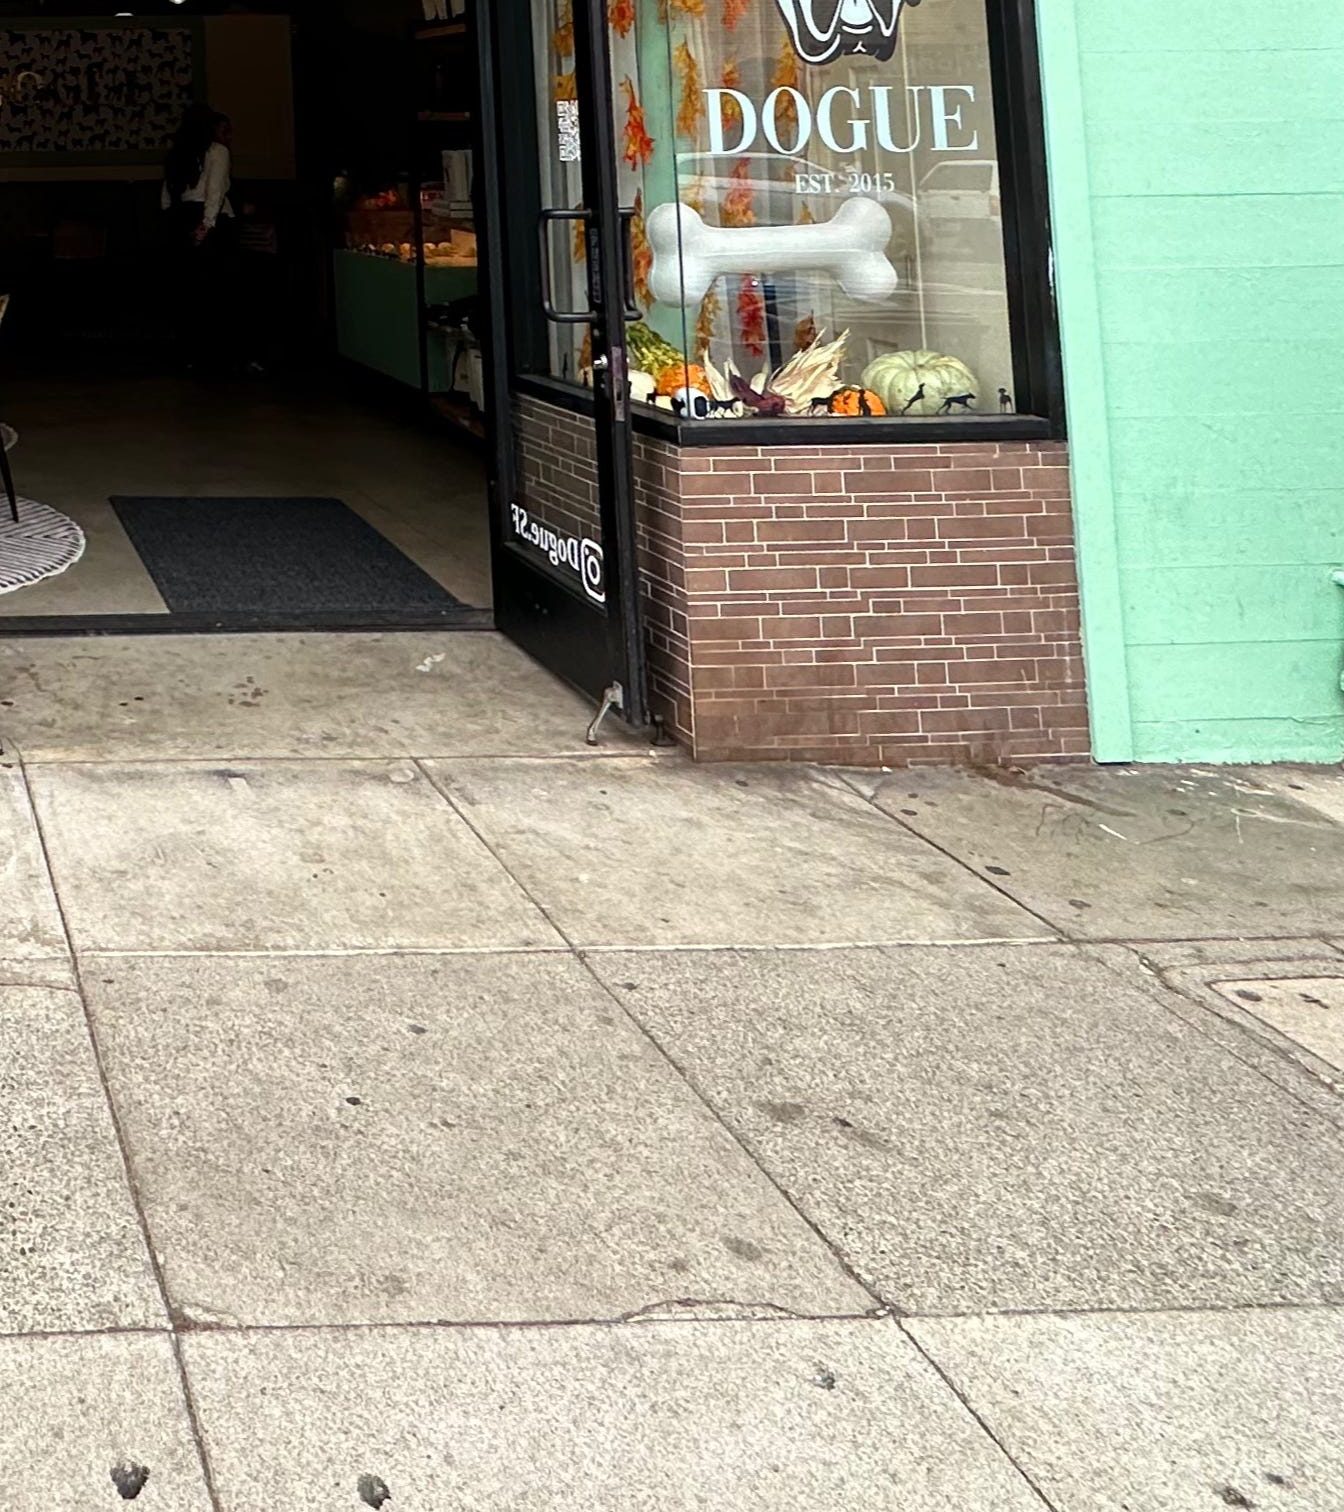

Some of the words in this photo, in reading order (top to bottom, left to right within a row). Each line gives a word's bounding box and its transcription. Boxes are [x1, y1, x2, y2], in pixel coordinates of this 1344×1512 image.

[703, 85, 977, 154] DOGUE
[794, 172, 840, 195] EST.
[849, 172, 895, 194] 2015
